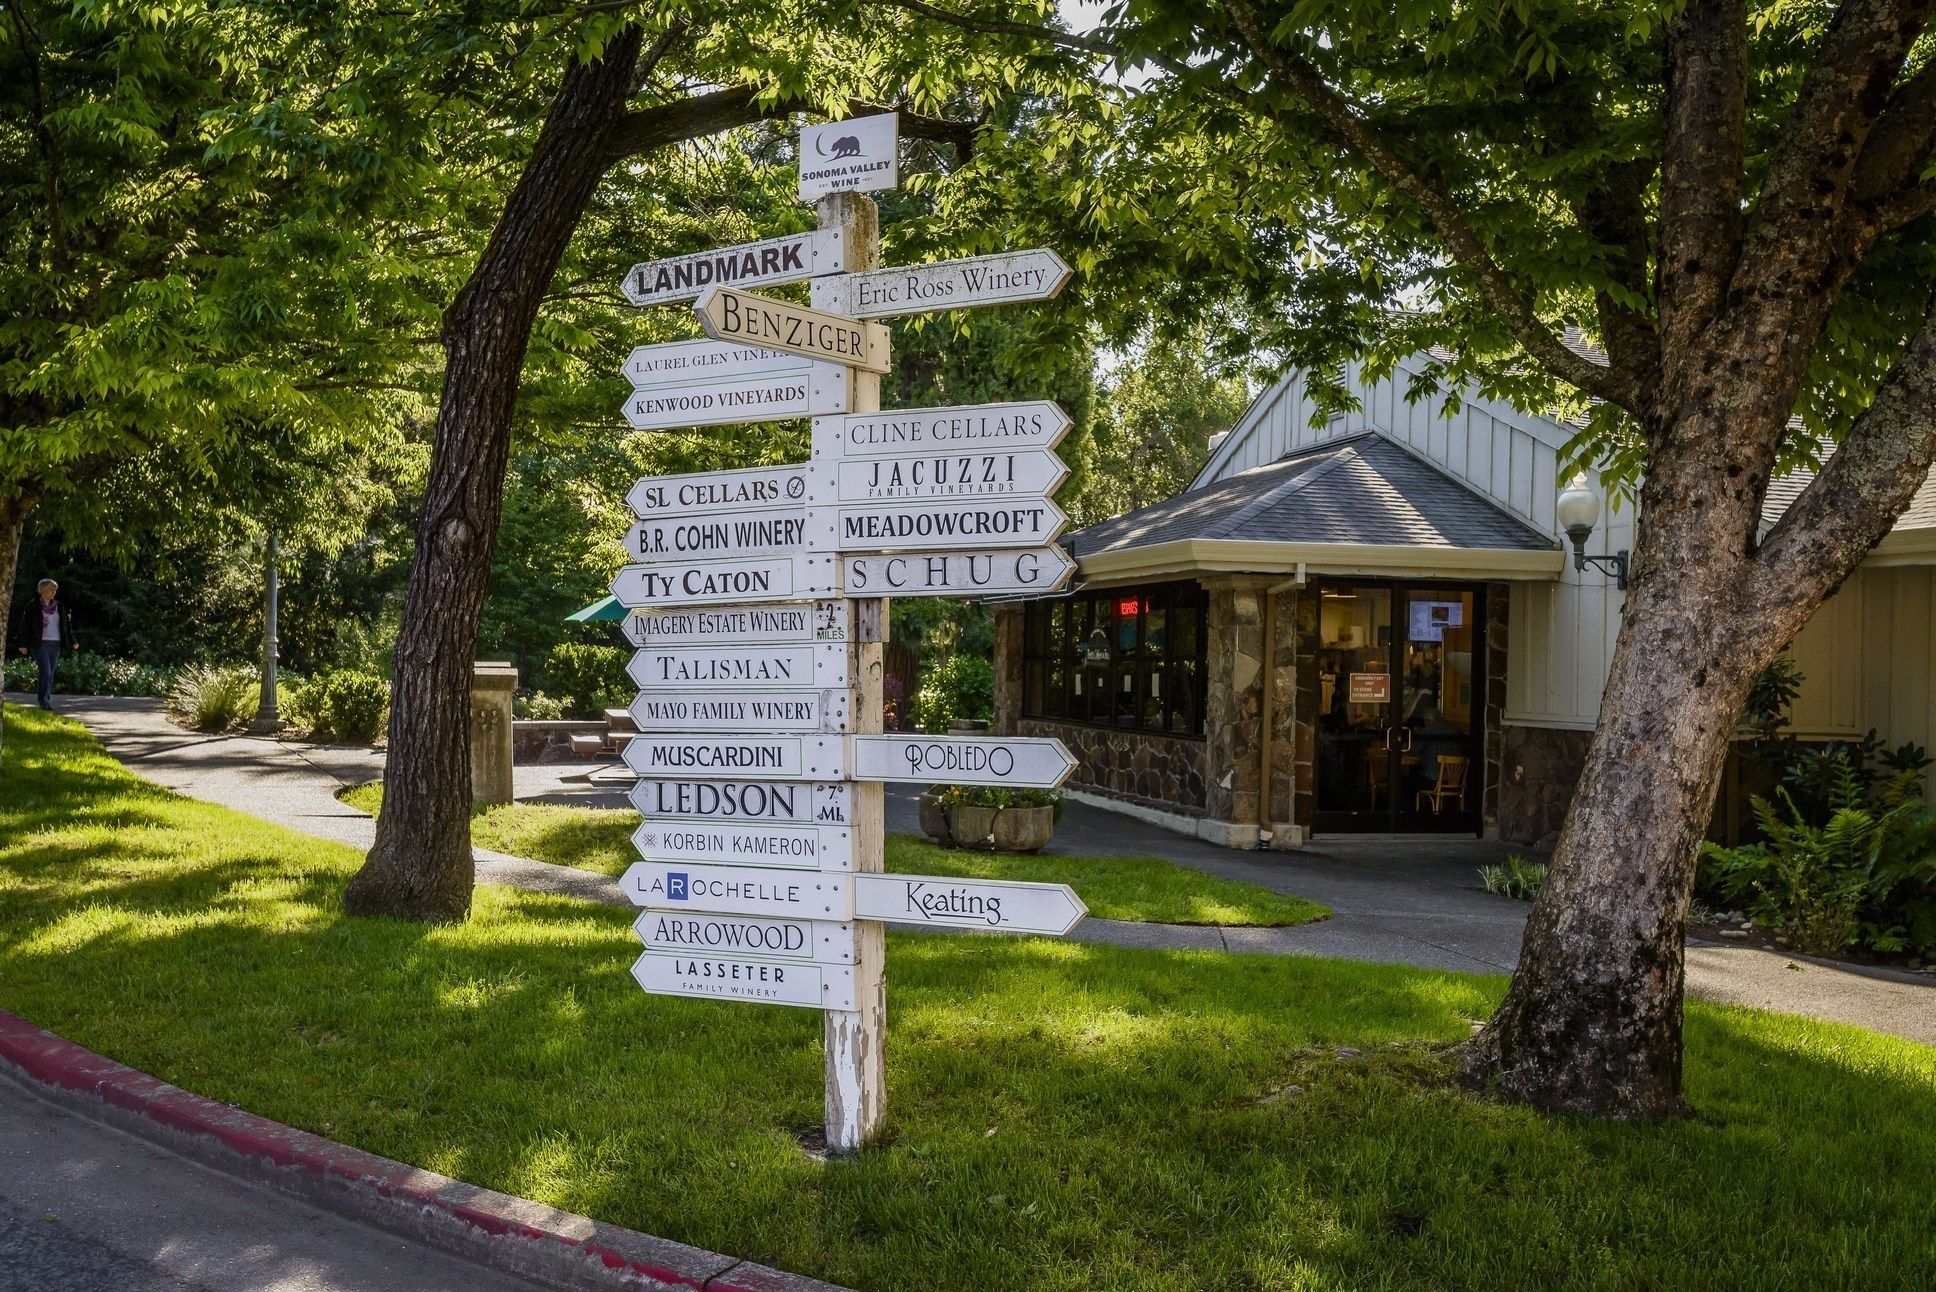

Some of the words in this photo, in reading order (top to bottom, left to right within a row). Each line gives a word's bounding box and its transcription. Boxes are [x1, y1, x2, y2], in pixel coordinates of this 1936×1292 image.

[801, 166, 848, 181] SONOMA
[849, 160, 892, 174] VALLEY
[831, 177, 860, 188] WINE
[637, 242, 804, 295] LANDMARK
[858, 282, 898, 306] Eric
[906, 276, 954, 300] Ross
[961, 266, 1046, 293] Winery
[721, 293, 864, 357] BENZIGER
[635, 357, 690, 373] LAUREL
[691, 352, 729, 369] GLEN
[635, 394, 713, 415] KENWOOD
[717, 385, 805, 407] VINEYARDS
[851, 421, 922, 445] CLINE
[932, 413, 1042, 440] CELLARS
[868, 455, 1015, 487] JACUZZI
[645, 487, 671, 509] SL
[678, 479, 779, 506] CELLARS
[868, 485, 919, 498] FAMILY
[930, 482, 1015, 495] VINEYARDS
[639, 528, 669, 554] B.R.
[675, 523, 728, 551] COHN
[734, 518, 805, 548] WINERY
[845, 508, 1044, 539] MEADOWCROFT
[682, 569, 770, 596] CATON
[851, 553, 1040, 589] SCHUG
[634, 614, 695, 635] IMAGERY
[698, 612, 746, 634] ESTATE
[749, 610, 806, 632] WINERY
[816, 630, 845, 640] MILES
[656, 656, 792, 680] TALISMAN
[647, 702, 687, 720] MAYO
[692, 702, 746, 720] FAMILY
[752, 702, 814, 720] WINERY
[651, 746, 783, 768] MUSCARDINI
[904, 744, 1014, 776] ROBLEDO
[653, 781, 797, 818] LEDSON
[663, 832, 724, 852] KORBIN
[732, 835, 815, 857] KAMERON
[905, 881, 1001, 926] Keating
[654, 916, 804, 951] ARROWOOD
[675, 960, 784, 983] LASSETER
[682, 982, 723, 993] FAMILY
[730, 986, 778, 997] WINERY
